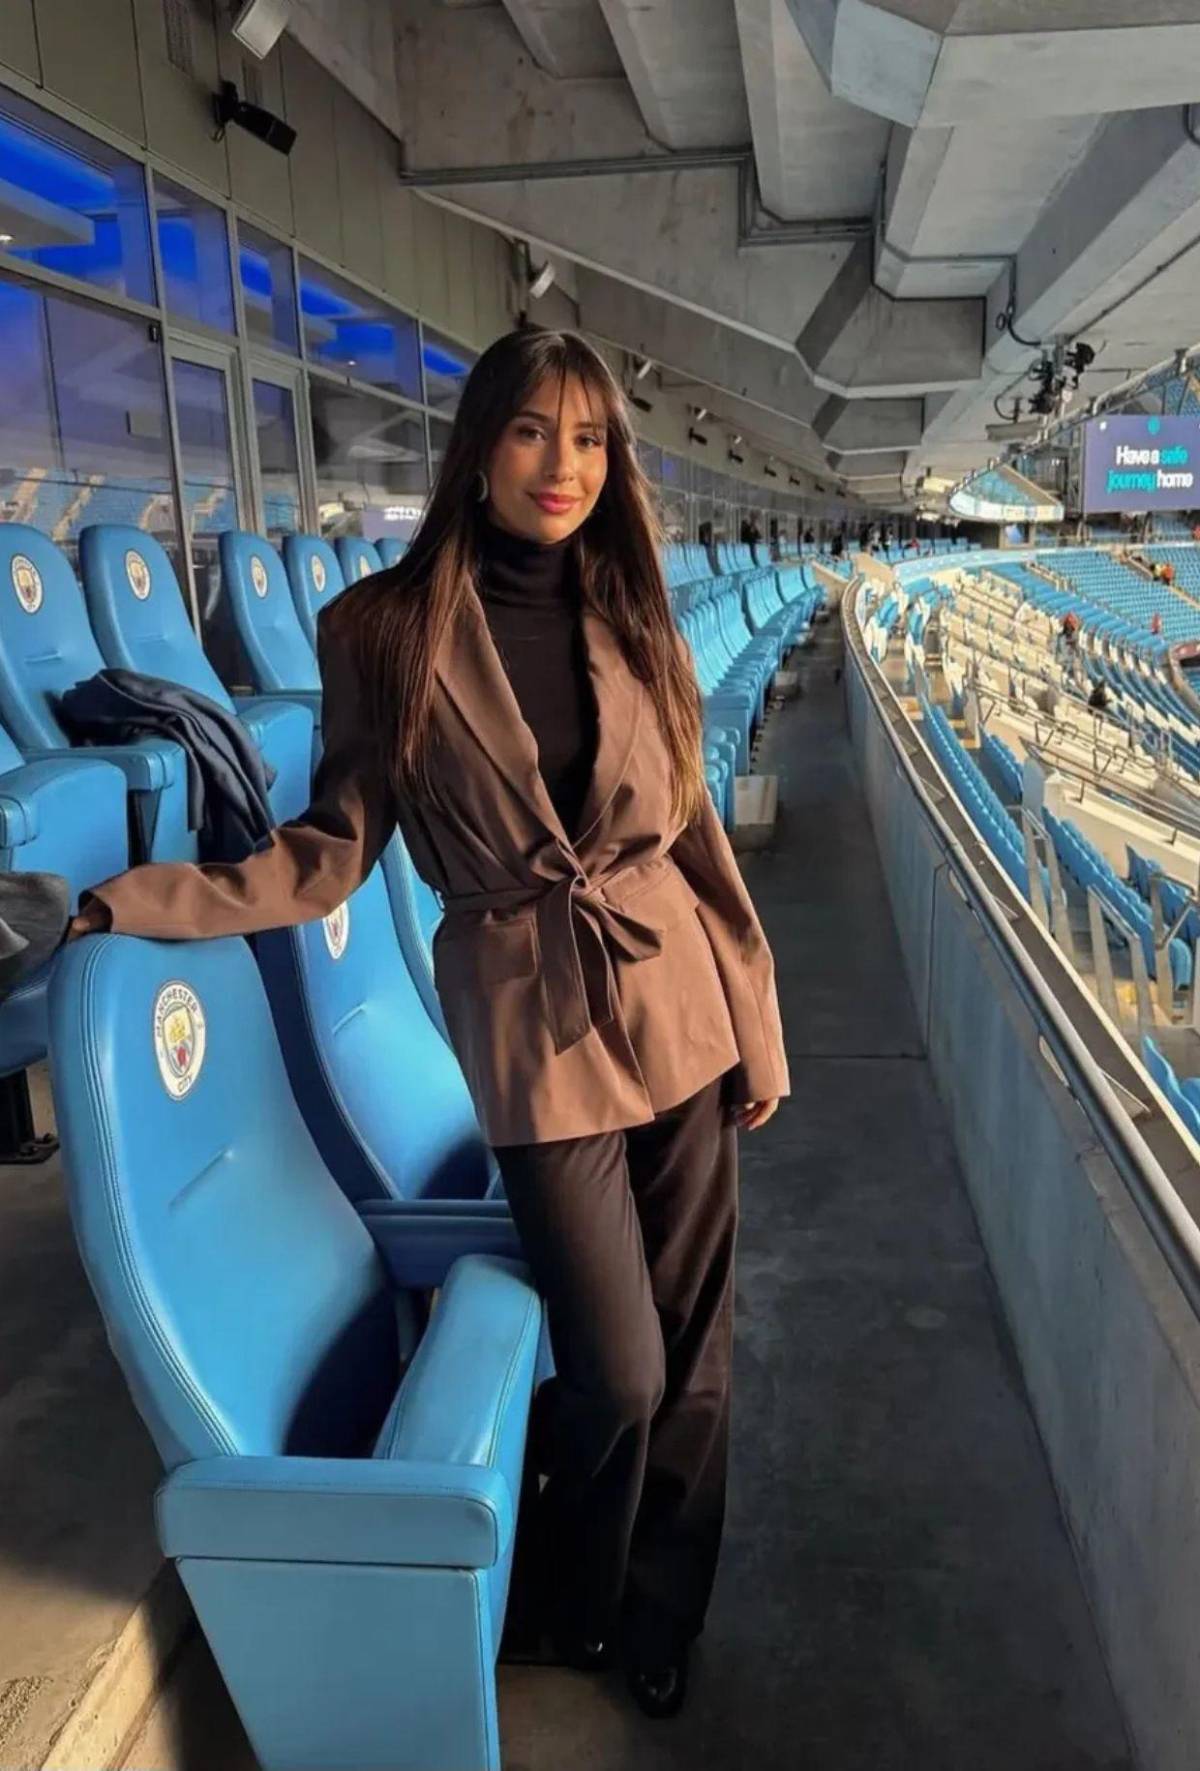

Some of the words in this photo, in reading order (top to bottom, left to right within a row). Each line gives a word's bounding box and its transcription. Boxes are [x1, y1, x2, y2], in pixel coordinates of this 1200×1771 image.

[1116, 445, 1150, 465] Have
[1151, 449, 1160, 465] a
[1161, 446, 1188, 465] safe
[1106, 470, 1156, 494] journey
[1157, 469, 1193, 488] home
[156, 988, 198, 1038] MANCHESTER
